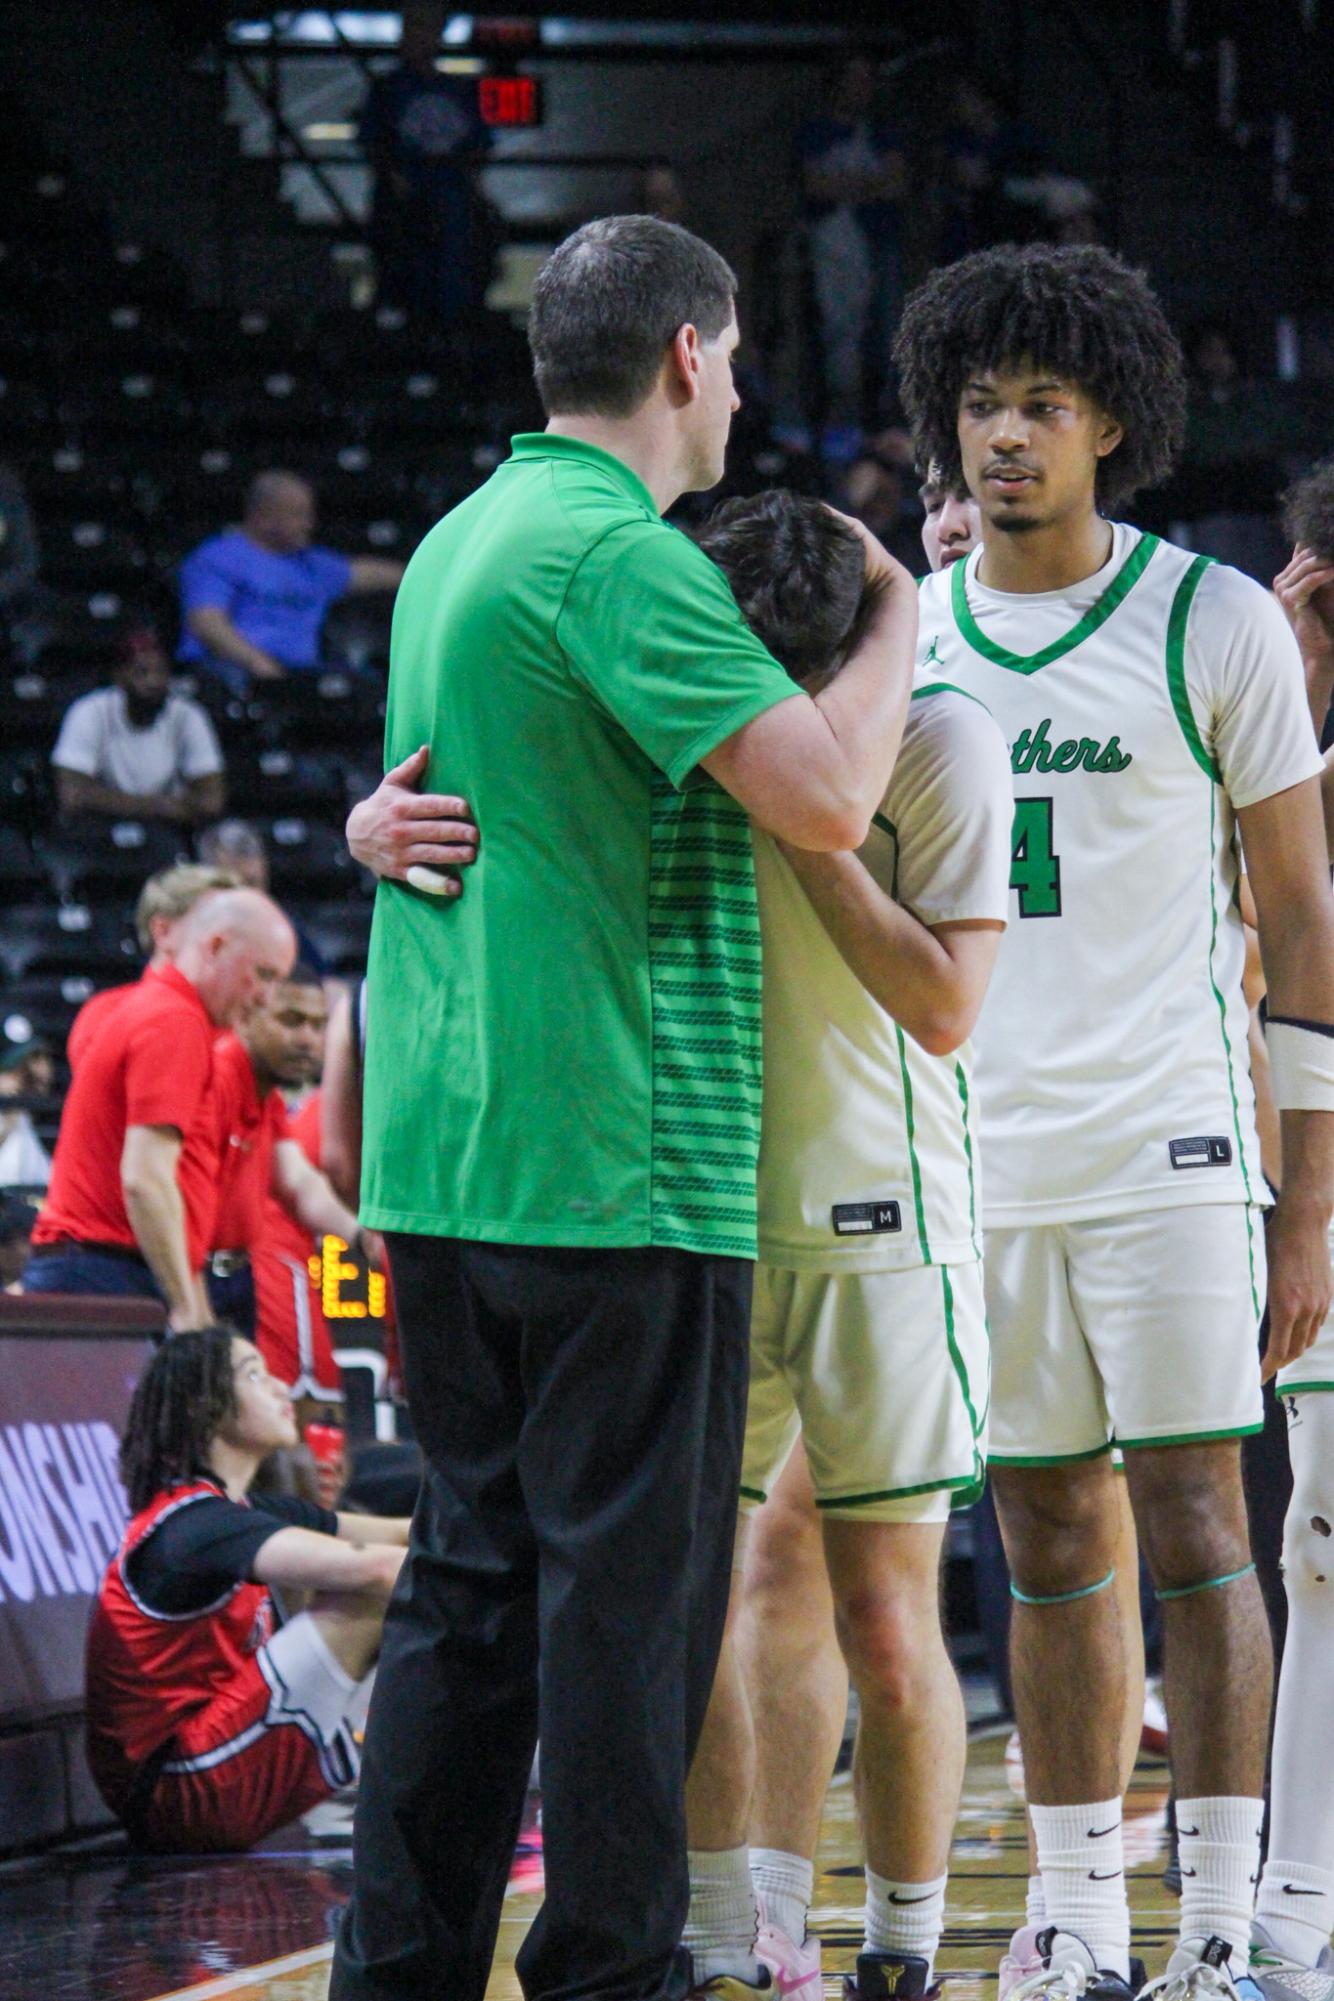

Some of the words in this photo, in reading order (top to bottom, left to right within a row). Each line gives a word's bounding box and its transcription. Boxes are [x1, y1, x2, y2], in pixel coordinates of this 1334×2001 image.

[1008, 718, 1132, 774] thers
[1216, 1145, 1224, 1156] L
[880, 1210, 891, 1223] M
